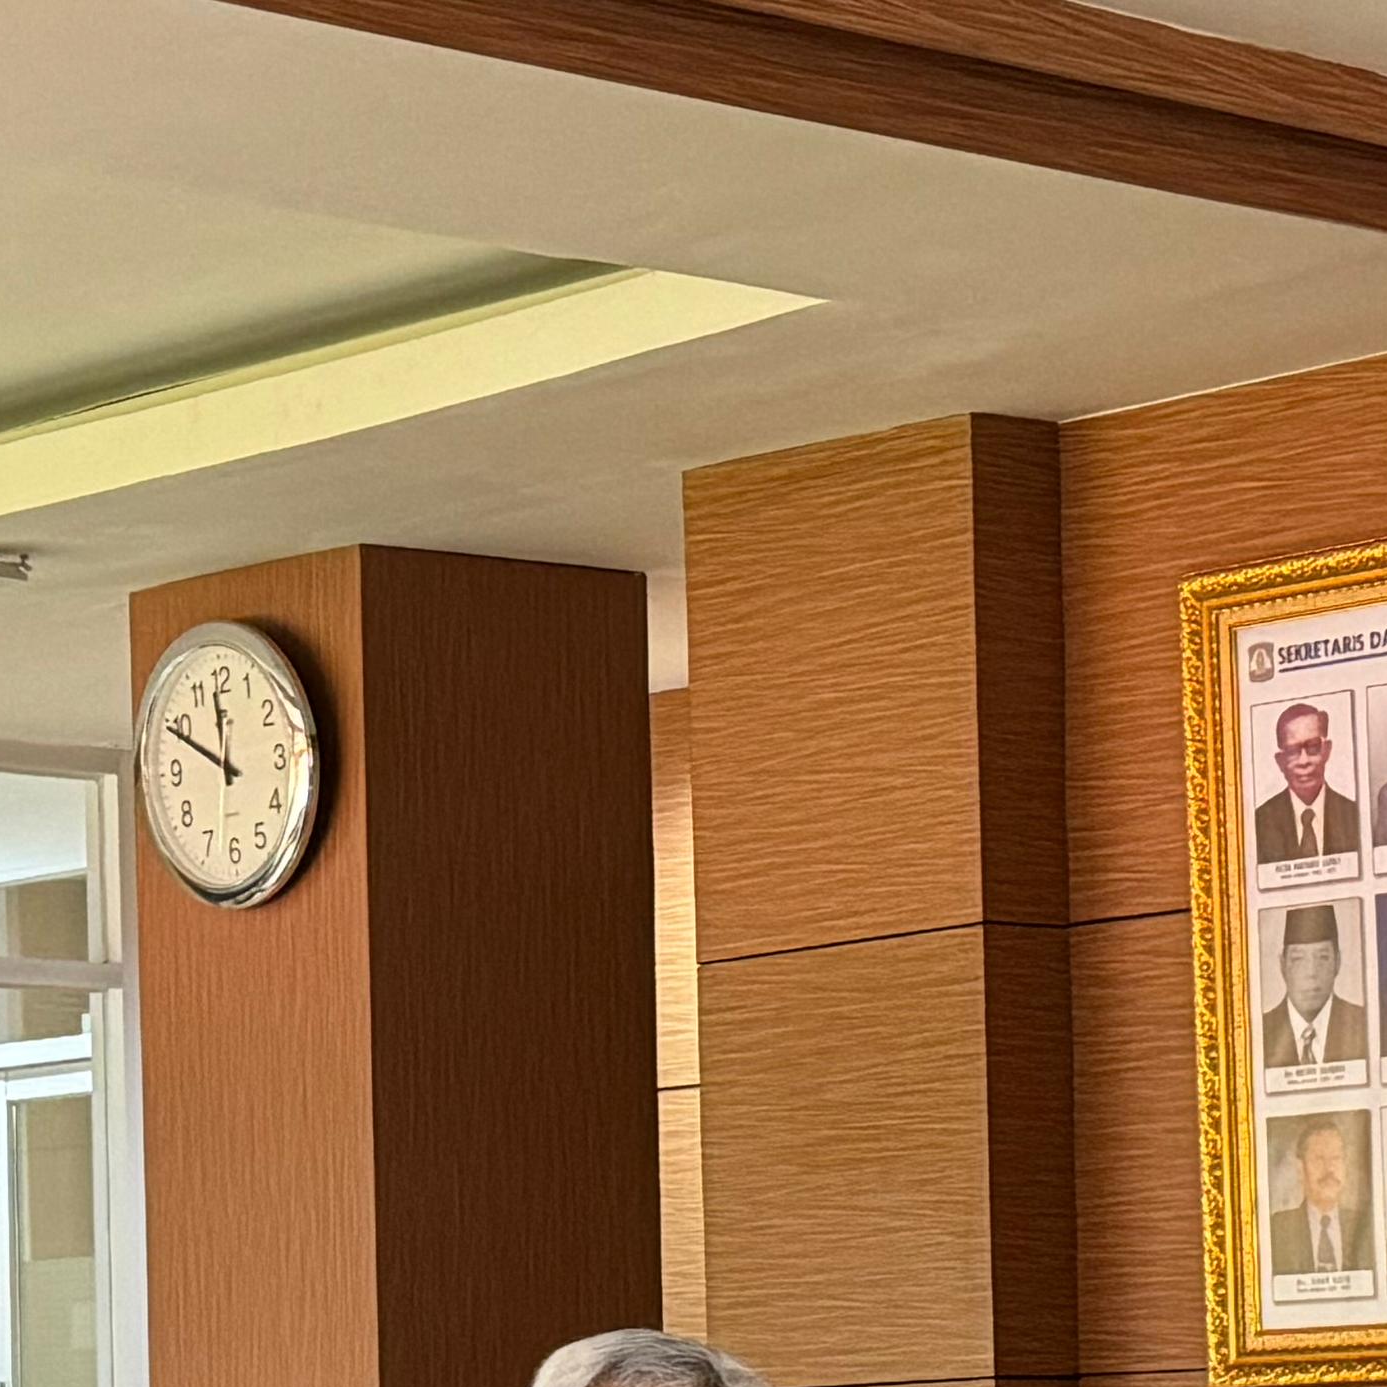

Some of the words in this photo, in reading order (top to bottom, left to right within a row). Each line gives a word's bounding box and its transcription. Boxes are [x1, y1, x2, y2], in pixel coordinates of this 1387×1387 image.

[1278, 633, 1364, 665] SEKRETARIS
[211, 666, 231, 694] 12
[243, 673, 252, 699] 1
[191, 681, 205, 708] 11
[262, 700, 276, 727] 2
[273, 743, 287, 770] 3
[170, 759, 182, 787] 9
[181, 800, 194, 827] 8
[268, 787, 282, 814] 4
[202, 830, 214, 857] 7
[254, 822, 267, 849] 5
[229, 837, 242, 864] 6
